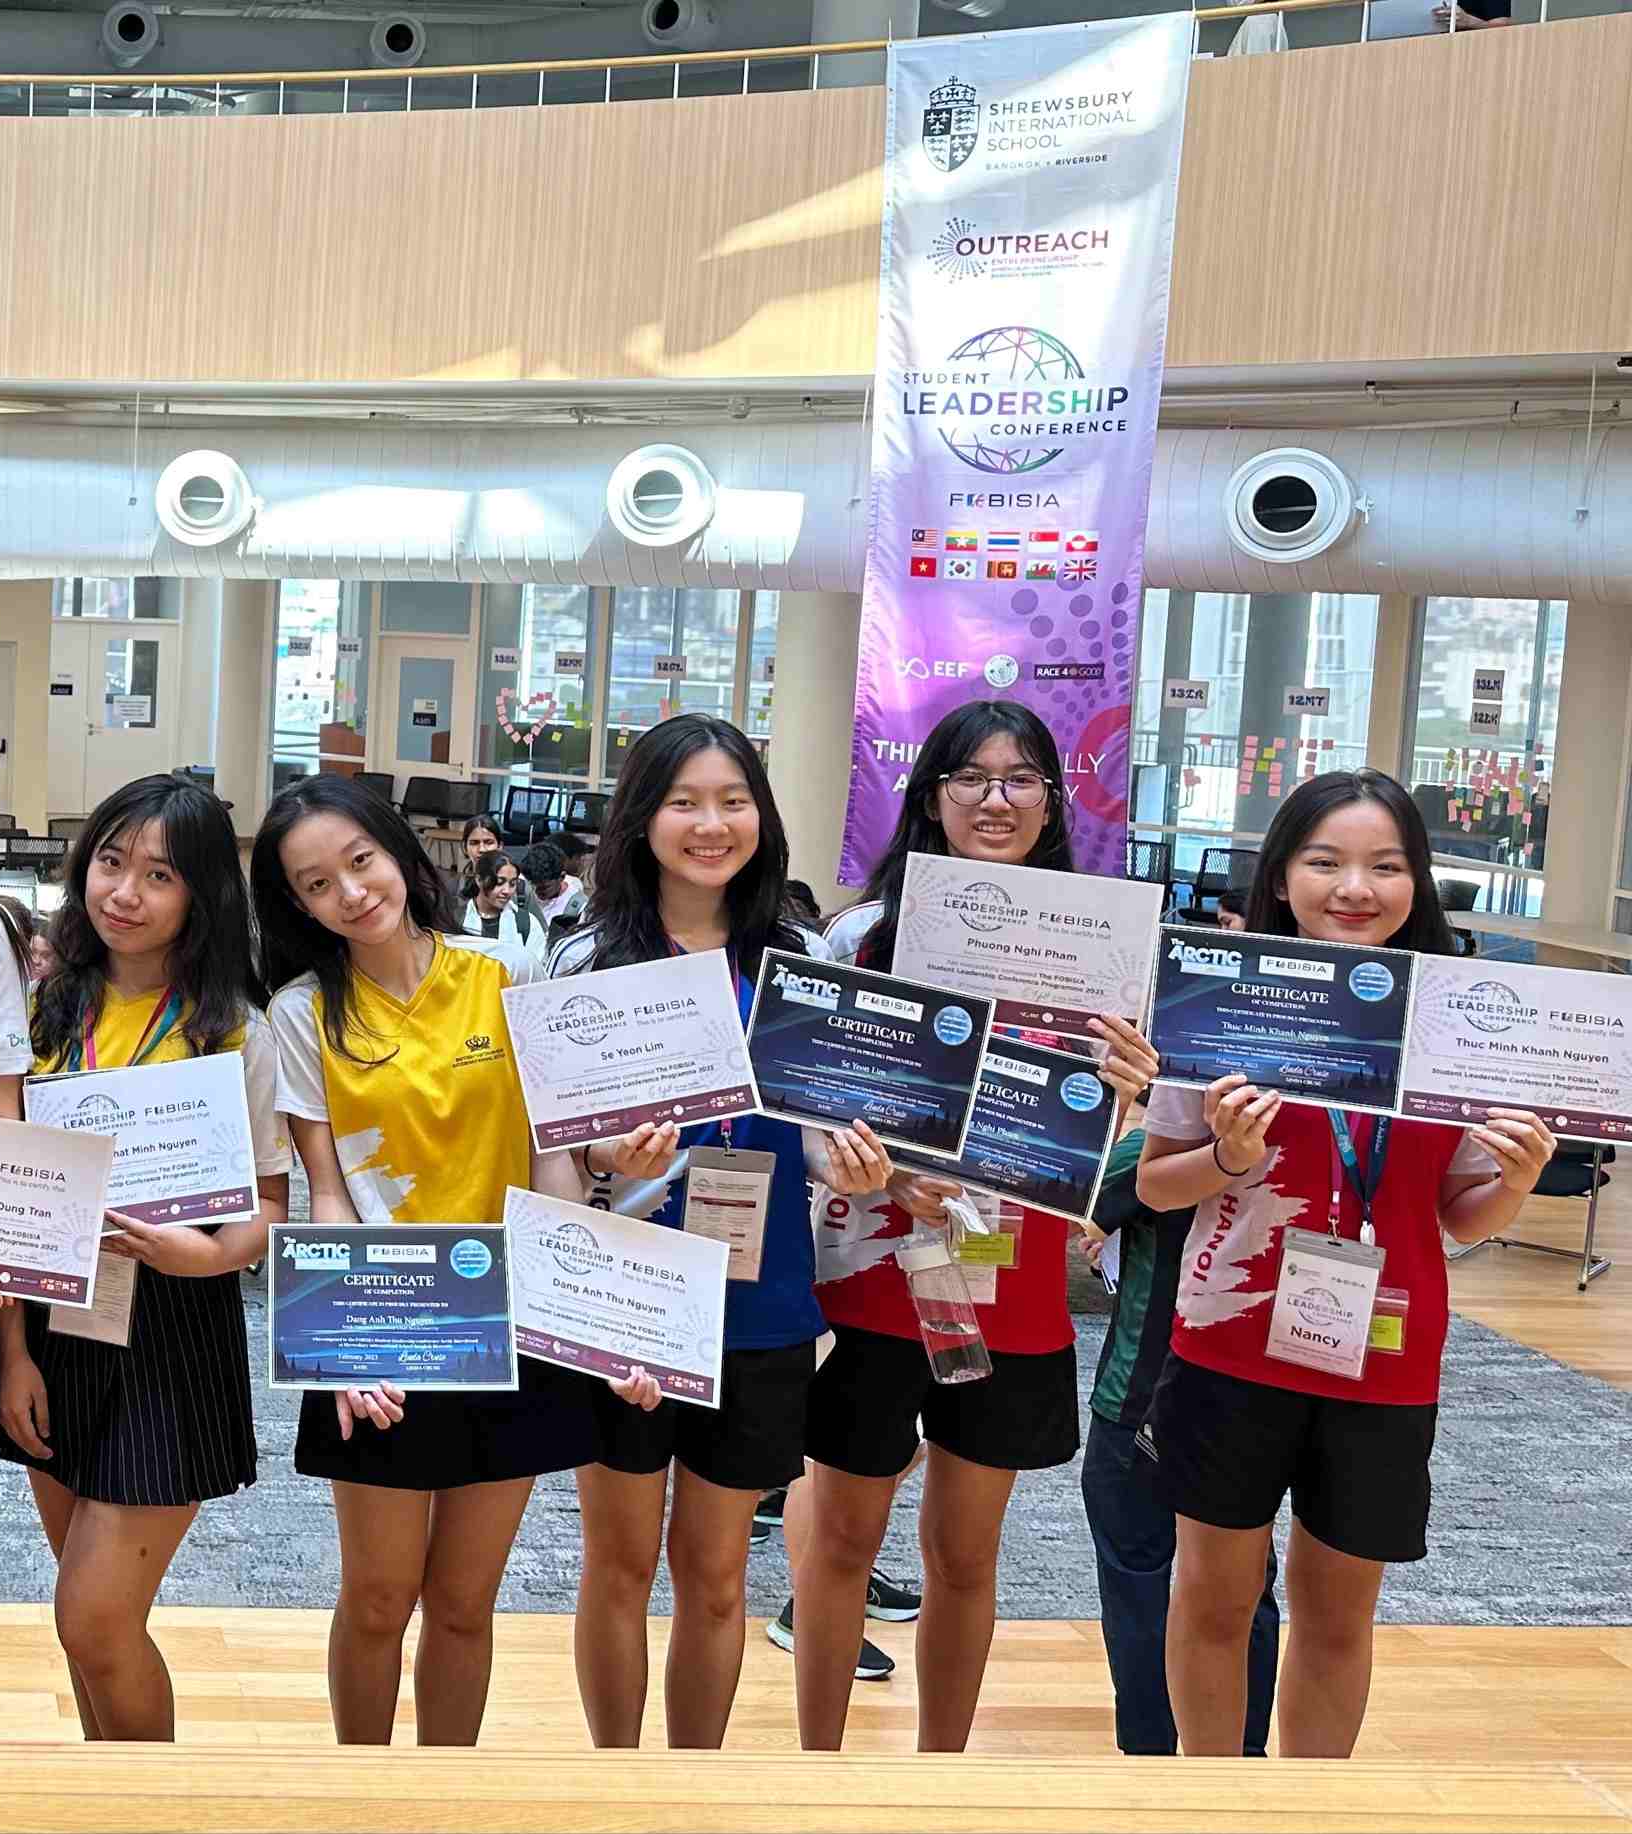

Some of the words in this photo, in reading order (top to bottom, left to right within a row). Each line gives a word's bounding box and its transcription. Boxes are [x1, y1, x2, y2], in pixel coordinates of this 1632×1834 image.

[989, 91, 1133, 116] SHREWSBURY
[988, 110, 1136, 134] INTERNATIONAL
[988, 135, 1062, 152] SCHOOL
[1056, 154, 1108, 166] RIVERSIDE
[956, 230, 1109, 256] OUTREACH
[904, 373, 990, 384] STUDENT
[903, 387, 1129, 415] LEADERSHIP
[990, 420, 1127, 435] CONFERENCE
[934, 661, 968, 677] EEF
[1037, 668, 1059, 676] RACE
[943, 897, 1028, 918] LEADERSHIP
[968, 937, 1010, 954] Phuong
[1015, 943, 1041, 958] Nghi
[1045, 949, 1078, 962] Pham
[1170, 938, 1184, 946] The
[1168, 943, 1242, 966] ARCTIC
[775, 963, 788, 974] The
[771, 971, 842, 1000] ARCTIC
[1231, 982, 1329, 1004] CERTIFICATE
[1447, 999, 1538, 1017] LEADERSHIP
[548, 1010, 625, 1033] LEADERSHIP
[827, 1015, 916, 1045] CERTIFICATE
[1244, 1023, 1266, 1034] Minh
[1268, 1026, 1296, 1037] Khanh
[601, 1050, 614, 1061] Se
[617, 1045, 643, 1057] Yeon
[646, 1041, 664, 1052] Lim
[1456, 1037, 1485, 1049] Thuc
[1488, 1042, 1518, 1054] Minh
[1521, 1046, 1560, 1059] Khanh
[1563, 1051, 1609, 1064] Nguyen
[841, 1059, 850, 1068] Se
[1464, 1071, 1507, 1083] Leadership
[1509, 1077, 1552, 1087] Conference
[1554, 1081, 1598, 1094] Programme
[63, 1110, 135, 1129] LEADERSHIP
[132, 1143, 156, 1155] Minh
[158, 1137, 197, 1152] Nguyen
[30, 1207, 52, 1219] Tran
[0, 1236, 39, 1249] Programme
[282, 1236, 297, 1244] The
[1193, 1193, 1239, 1282] HANOI
[282, 1243, 351, 1259] ARCTIC
[539, 1238, 614, 1263] LEADERSHIP
[343, 1275, 434, 1287] CERTIFICATE
[553, 1277, 579, 1294] Dang
[583, 1287, 602, 1299] Anh
[606, 1292, 624, 1305] Thu
[627, 1298, 666, 1316] Nguyen
[346, 1315, 367, 1325] Dang
[369, 1315, 386, 1324] Anh
[387, 1315, 404, 1324] Thu
[1290, 1325, 1341, 1348] Nancy
